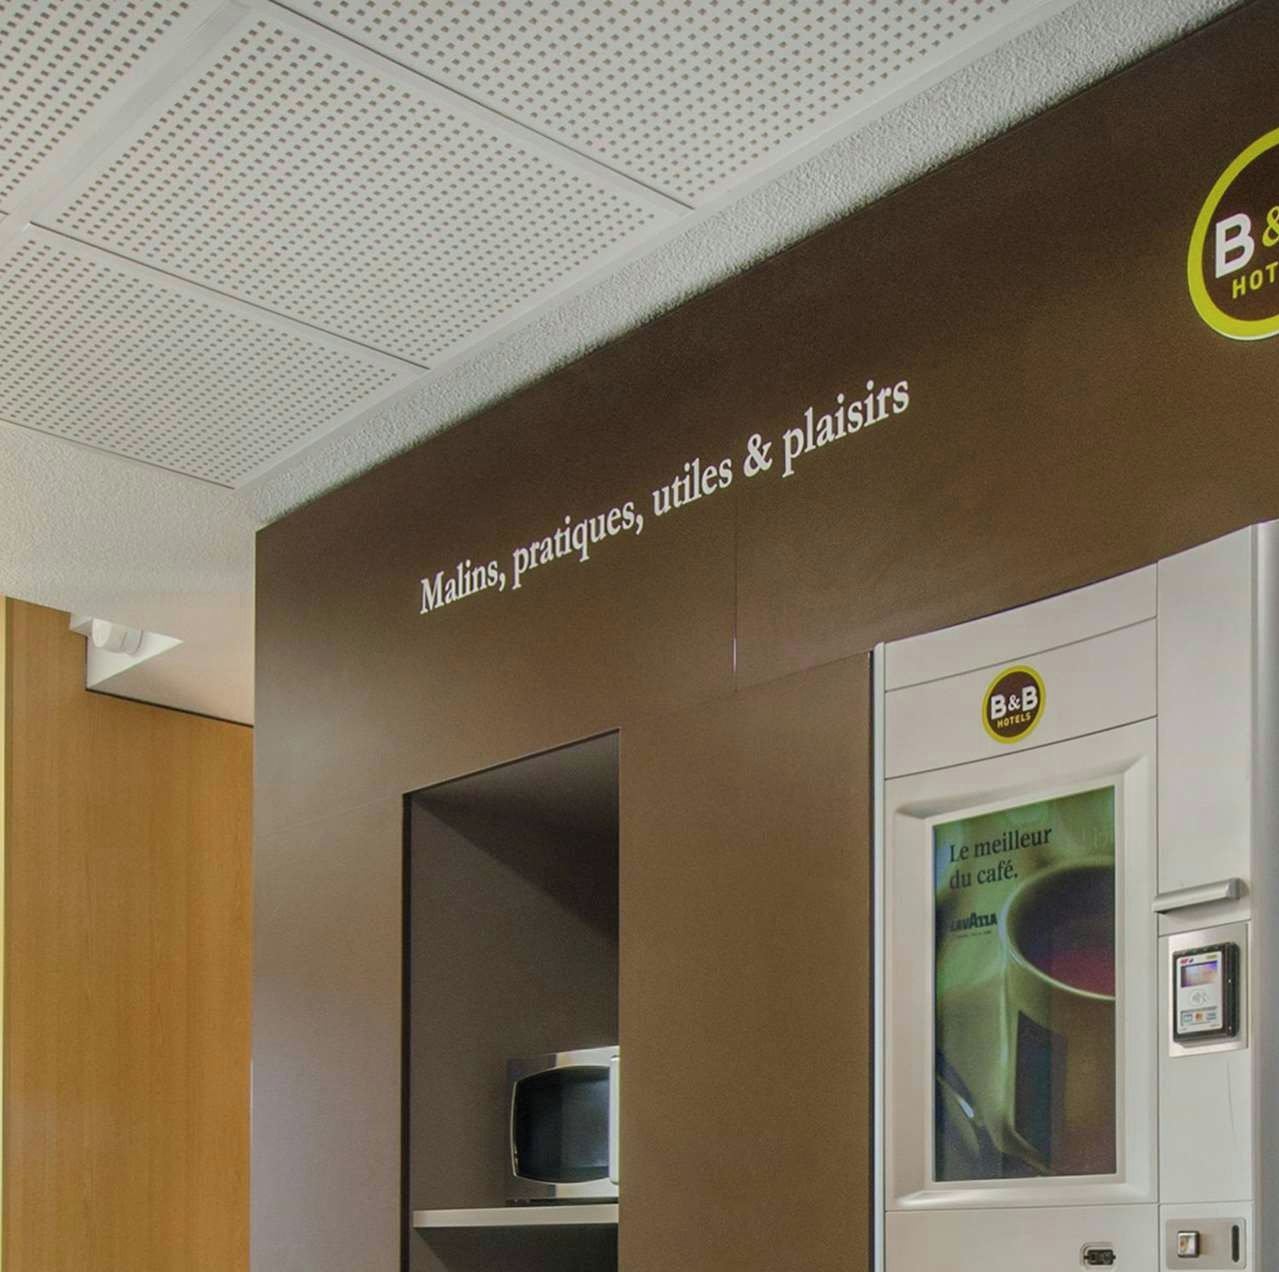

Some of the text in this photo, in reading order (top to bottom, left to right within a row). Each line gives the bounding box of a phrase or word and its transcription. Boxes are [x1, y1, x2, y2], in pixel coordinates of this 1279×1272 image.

[420, 379, 910, 615] Malins, pratiques, utiles & plaisirs
[991, 685, 1039, 721] B&B
[996, 711, 1032, 729] HOTELS
[949, 827, 1053, 863] Le meilleur
[949, 859, 1019, 890] du café.
